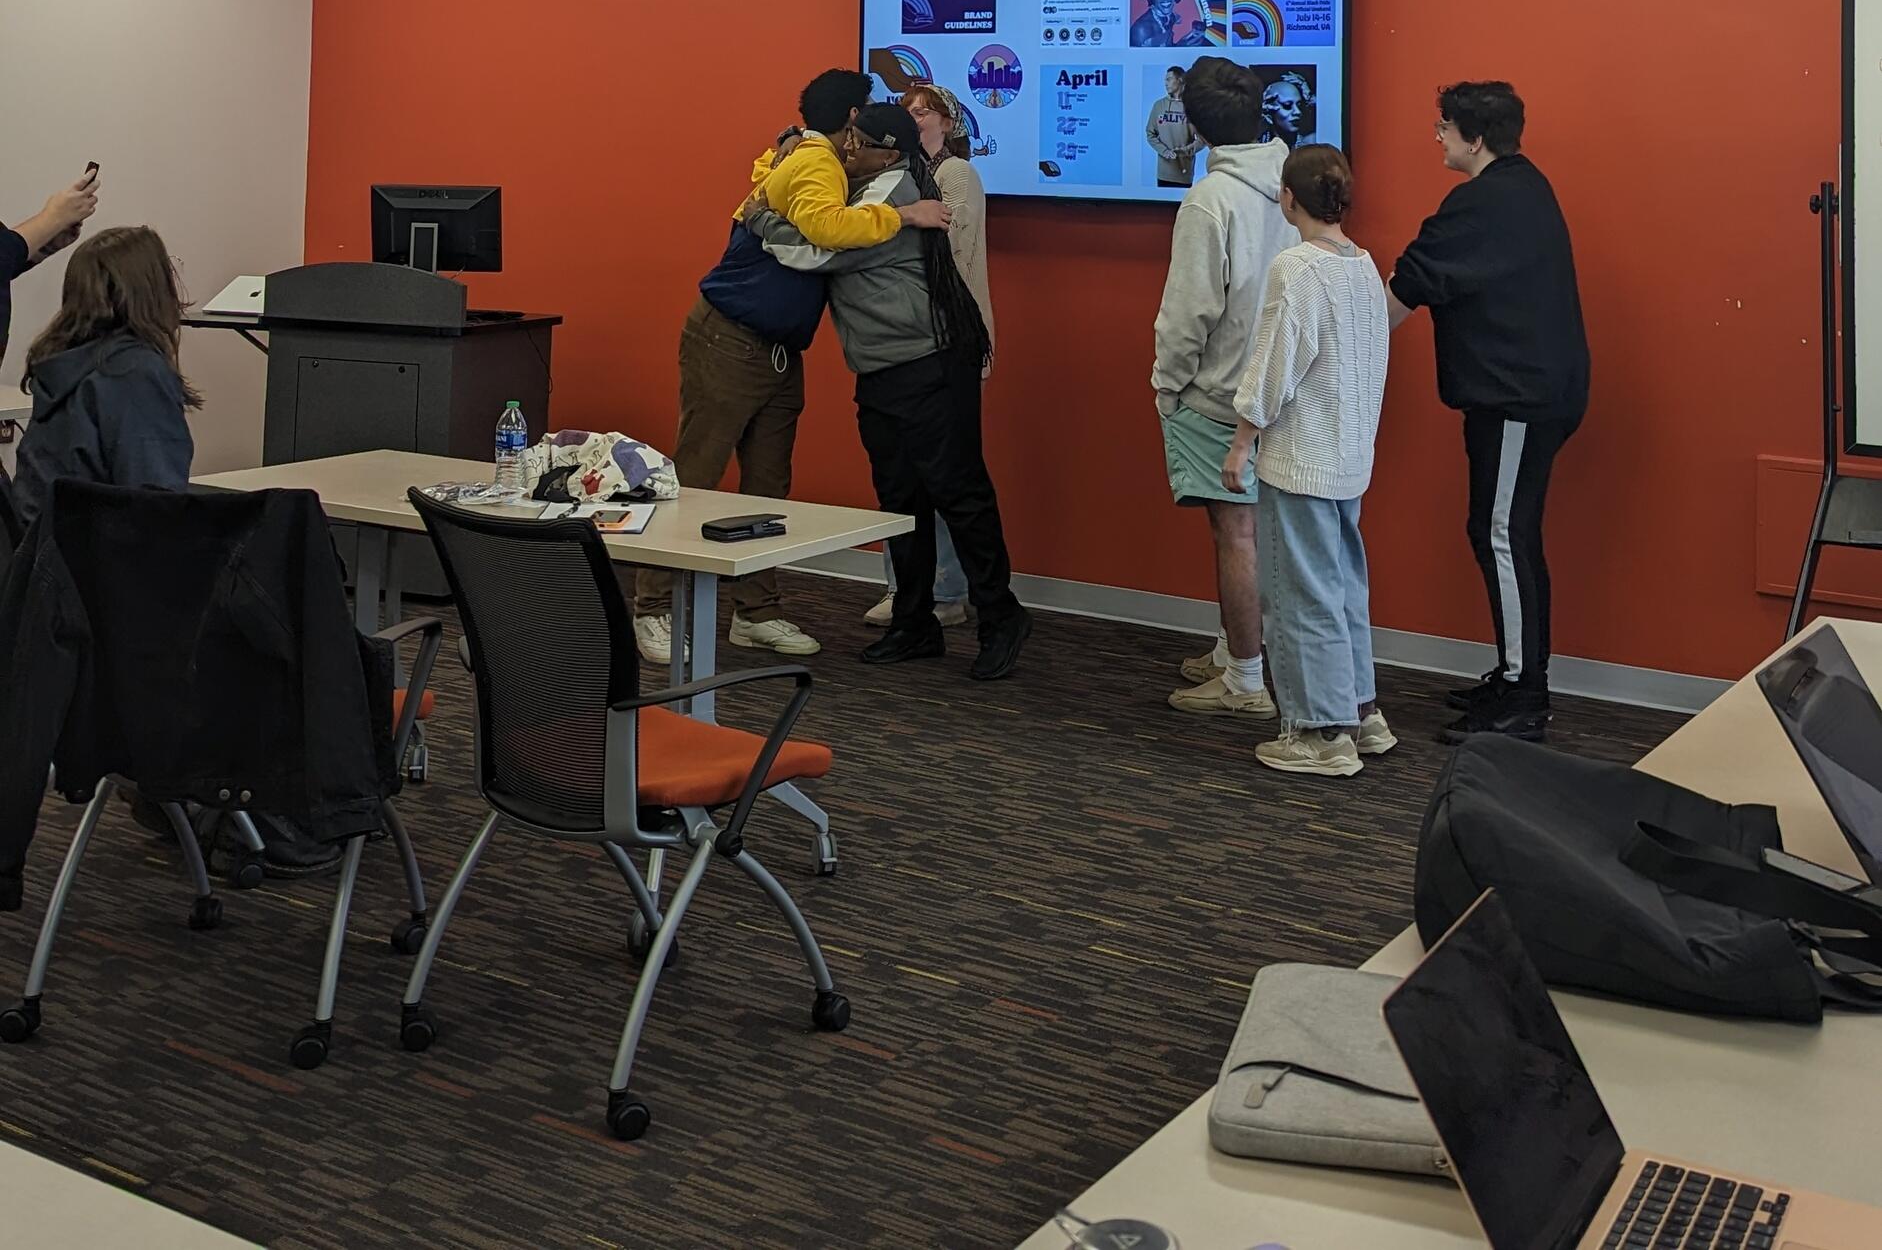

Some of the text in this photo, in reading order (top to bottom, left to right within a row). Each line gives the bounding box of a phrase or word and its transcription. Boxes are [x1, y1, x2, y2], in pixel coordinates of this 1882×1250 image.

[964, 11, 993, 20] BRAND
[1295, 13, 1331, 22] July 14-16
[944, 21, 993, 30] GUIDELINES
[1320, 23, 1331, 31] VA
[1056, 69, 1108, 90] April
[1163, 113, 1187, 125] ALIV
